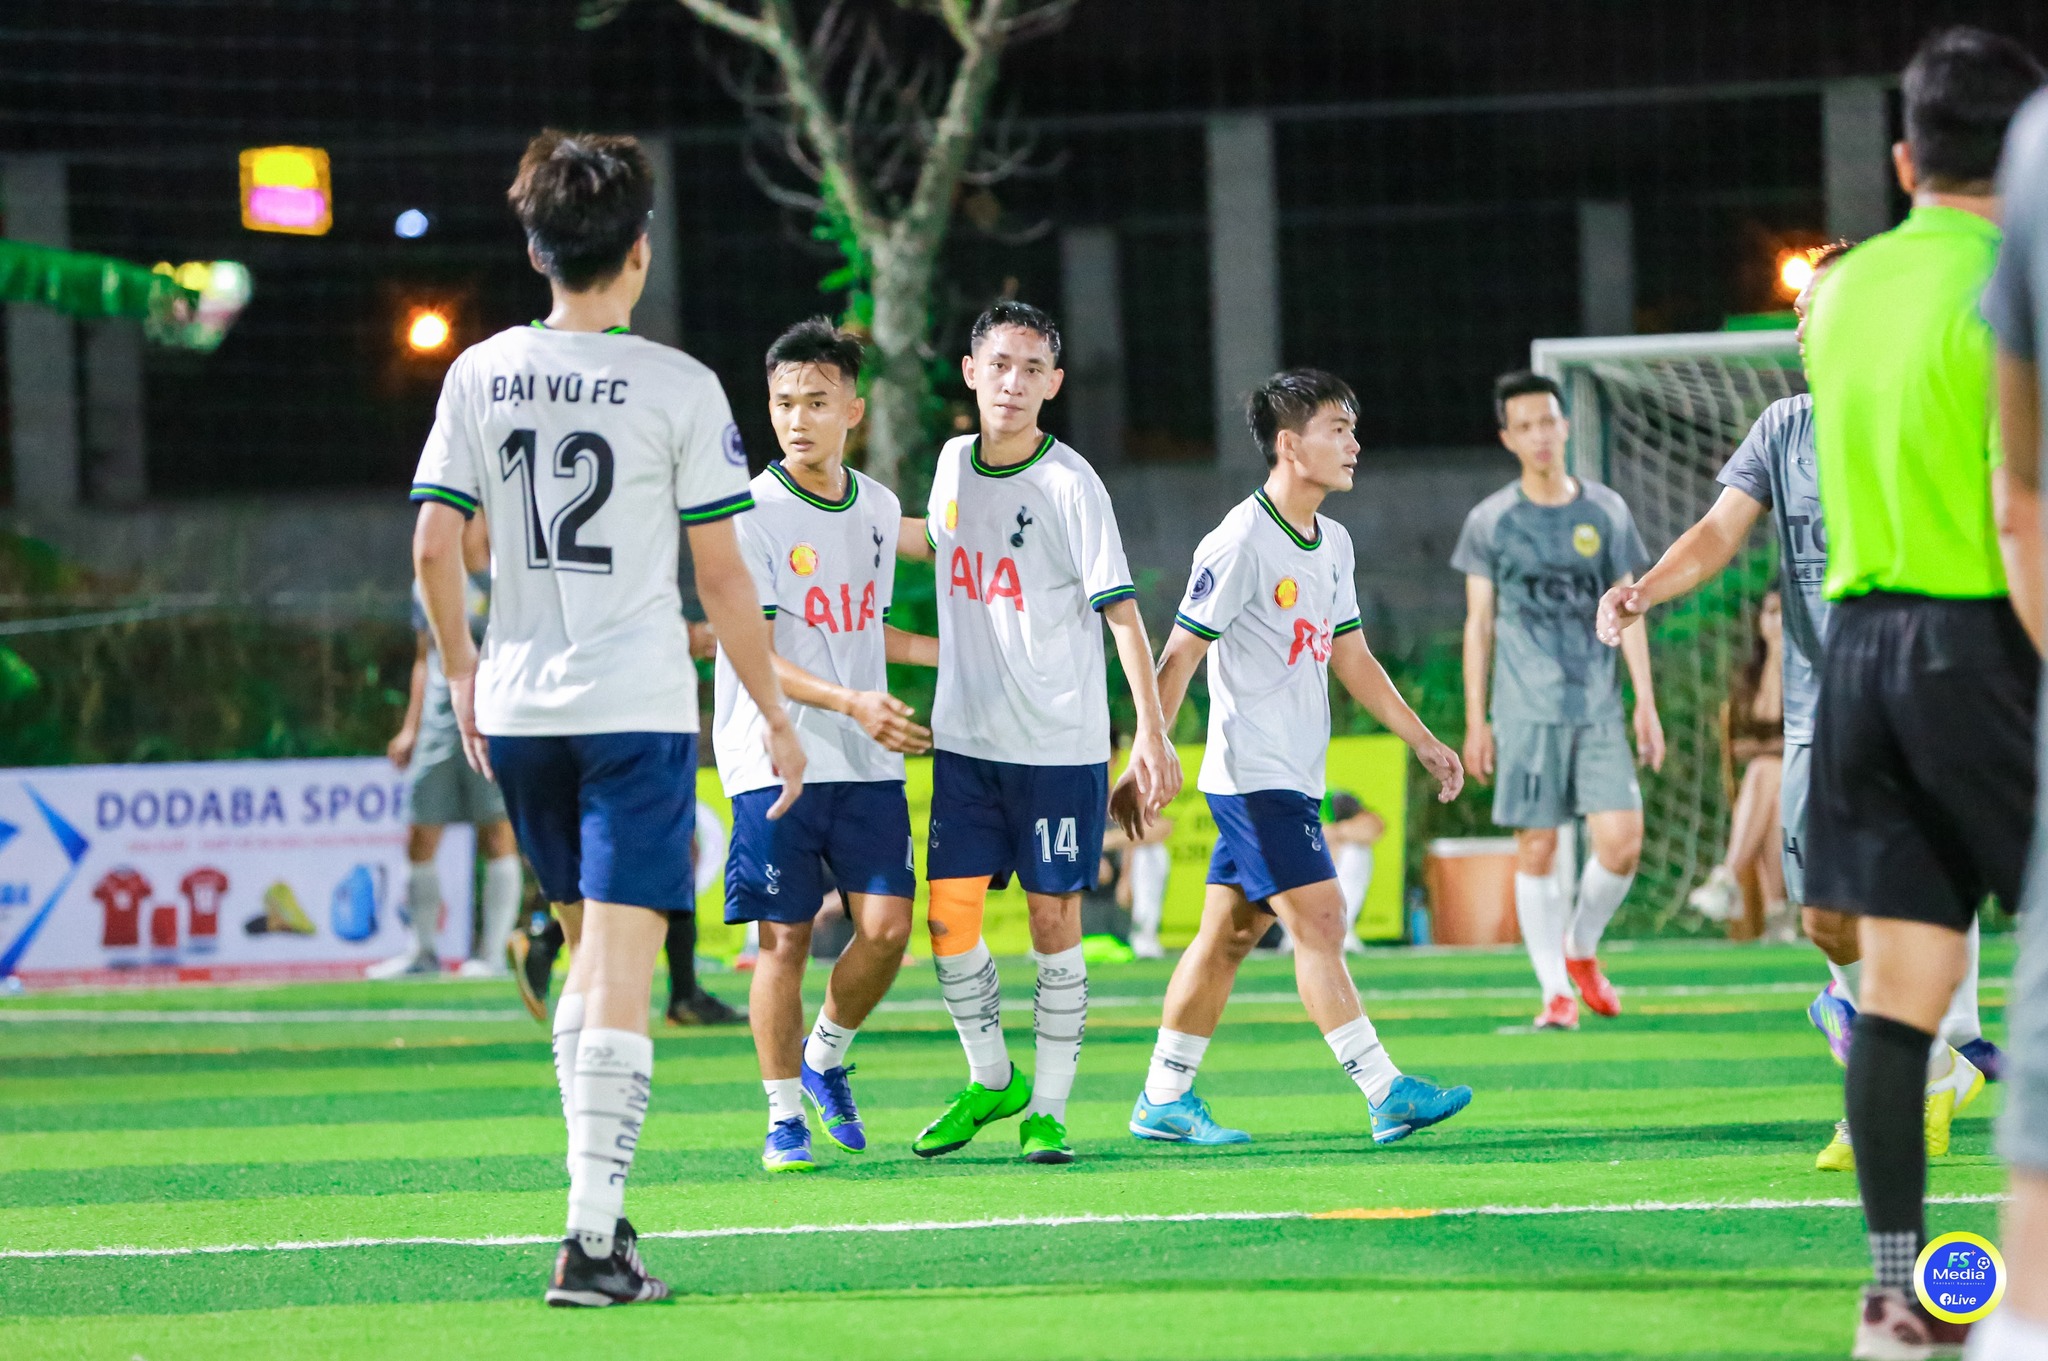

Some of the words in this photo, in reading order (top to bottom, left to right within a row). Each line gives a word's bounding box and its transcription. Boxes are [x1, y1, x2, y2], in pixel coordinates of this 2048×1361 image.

[492, 374, 535, 407] ĐẠI
[546, 372, 583, 402] VŨ
[591, 379, 629, 404] FC
[499, 428, 615, 575] 12
[948, 545, 1025, 613] AIA
[95, 786, 285, 830] DODABA
[1034, 817, 1080, 863] 14
